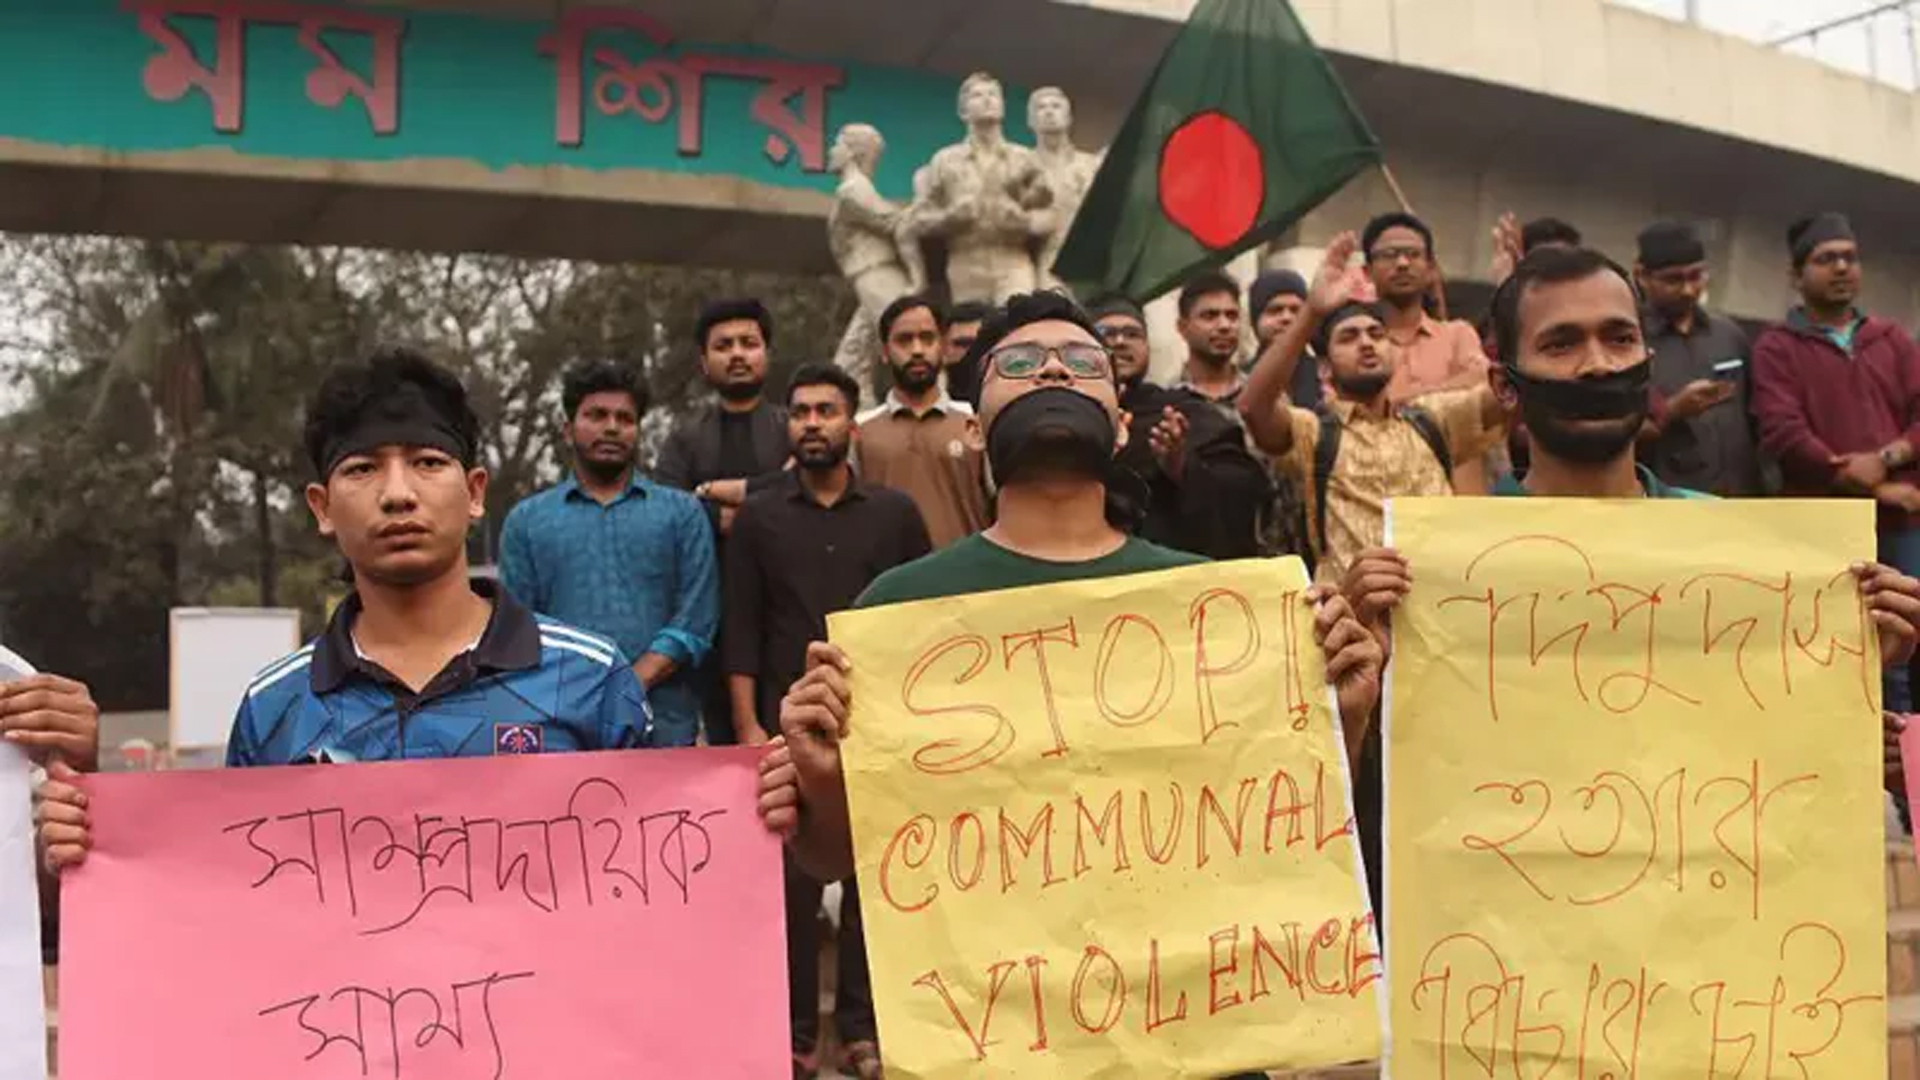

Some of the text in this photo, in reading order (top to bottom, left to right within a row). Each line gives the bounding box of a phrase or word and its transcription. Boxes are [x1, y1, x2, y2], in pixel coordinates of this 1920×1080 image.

[120, 0, 845, 173] মম শির
[901, 586, 1310, 775] STOP!
[1437, 535, 1702, 722] দিপু
[879, 760, 1356, 913] COMMUNAL
[1462, 758, 1820, 921] হত্যার
[257, 971, 536, 1080] সাম্য
[912, 912, 1384, 1062] VIOLENCE
[1411, 922, 1884, 1080] বিচার চাই
